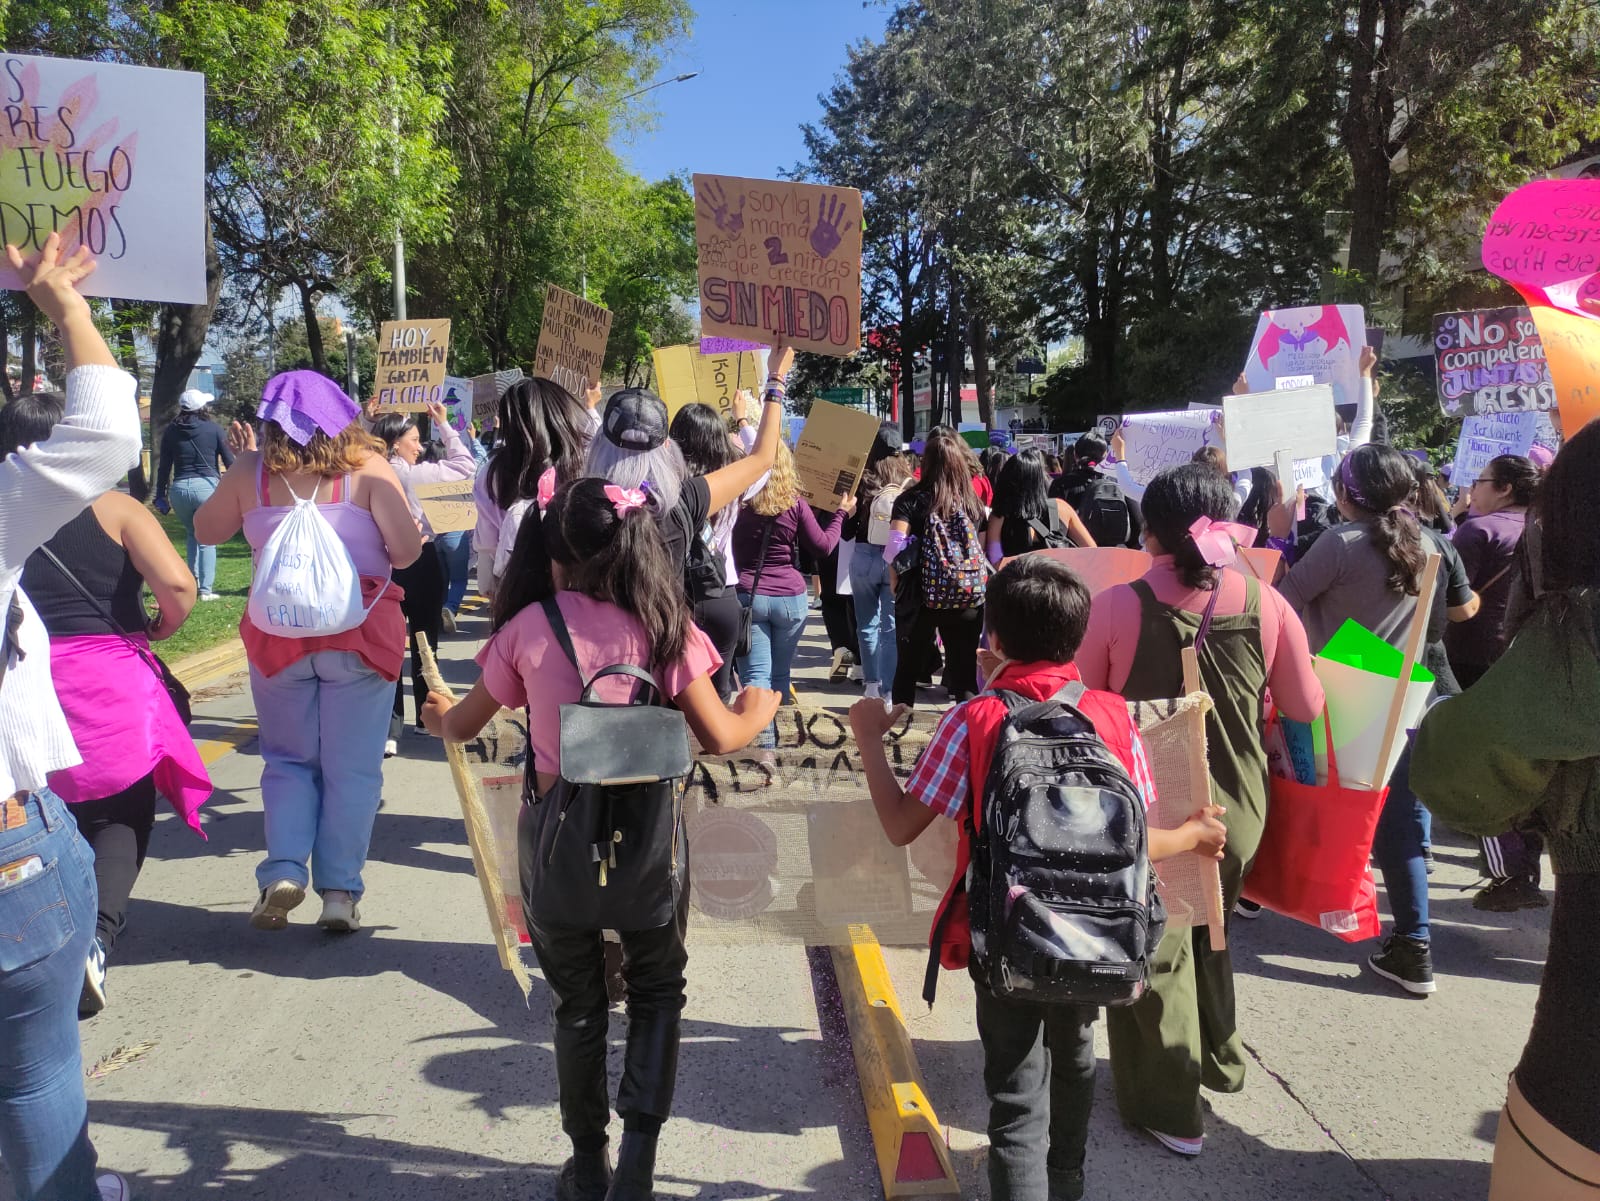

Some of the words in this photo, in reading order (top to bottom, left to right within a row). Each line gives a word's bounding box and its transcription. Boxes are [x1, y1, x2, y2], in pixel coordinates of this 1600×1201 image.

[17, 145, 132, 193] FUEGO
[0, 202, 126, 260] DEMOS
[736, 238, 758, 260] de
[763, 236, 789, 266] 2
[793, 250, 850, 278] niñas
[729, 260, 759, 282] que
[768, 265, 841, 292] crecerán
[547, 288, 558, 304] NO
[573, 299, 607, 326] NORMAL
[703, 277, 758, 327] SIN
[762, 285, 849, 346] MIEDO
[391, 327, 431, 350] HOY
[543, 316, 576, 344] MUJERES
[563, 312, 585, 333] TODAS
[587, 321, 603, 339] LAS
[1458, 315, 1504, 347] No
[380, 339, 444, 367] TAMBIÉN
[538, 343, 553, 359] UNA
[556, 350, 591, 378] HISTORIA
[560, 339, 602, 369] TENGAMOS
[388, 368, 429, 384] GRITA
[536, 356, 547, 373] DE
[550, 364, 587, 399] ACOSO
[1444, 362, 1540, 396] JUNTAS
[379, 388, 397, 405] EL
[401, 384, 443, 404] CIELO
[1104, 421, 1113, 430] 50
[1143, 418, 1197, 441] FEMINISTA
[275, 581, 303, 596] PARA
